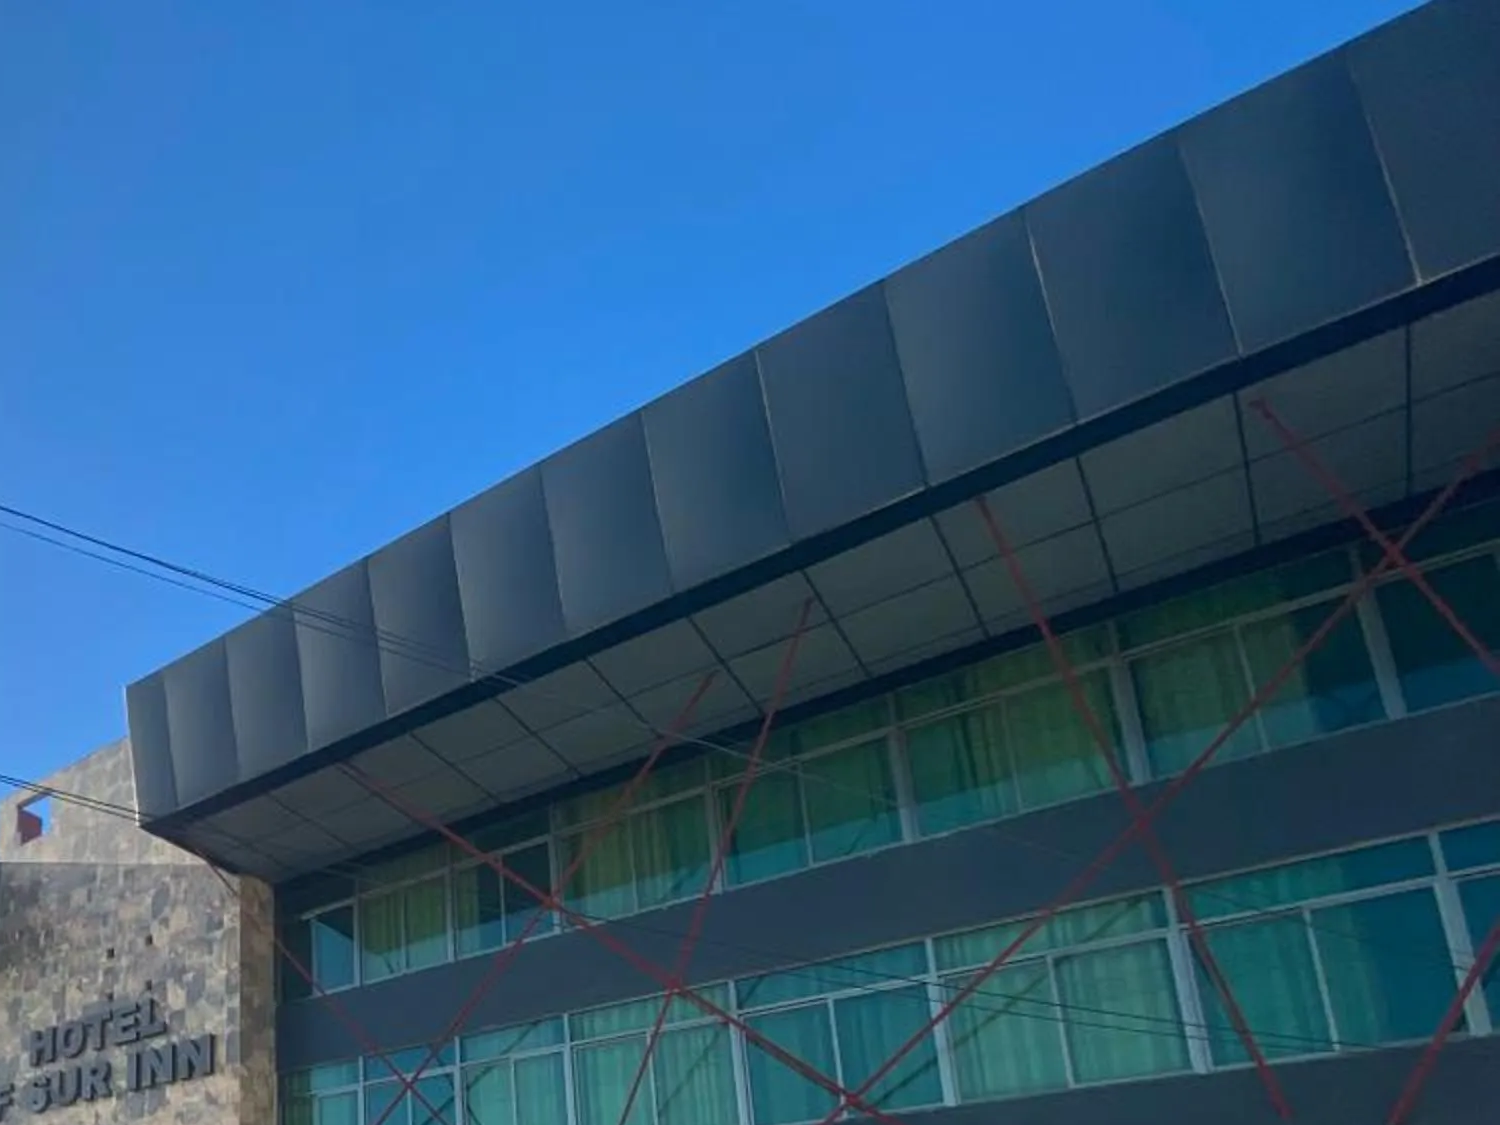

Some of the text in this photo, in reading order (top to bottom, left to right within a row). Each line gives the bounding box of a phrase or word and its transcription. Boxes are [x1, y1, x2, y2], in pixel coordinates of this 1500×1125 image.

[28, 995, 167, 1066] HOTEL
[29, 1058, 112, 1113] SUR
[126, 1033, 215, 1092] INN
